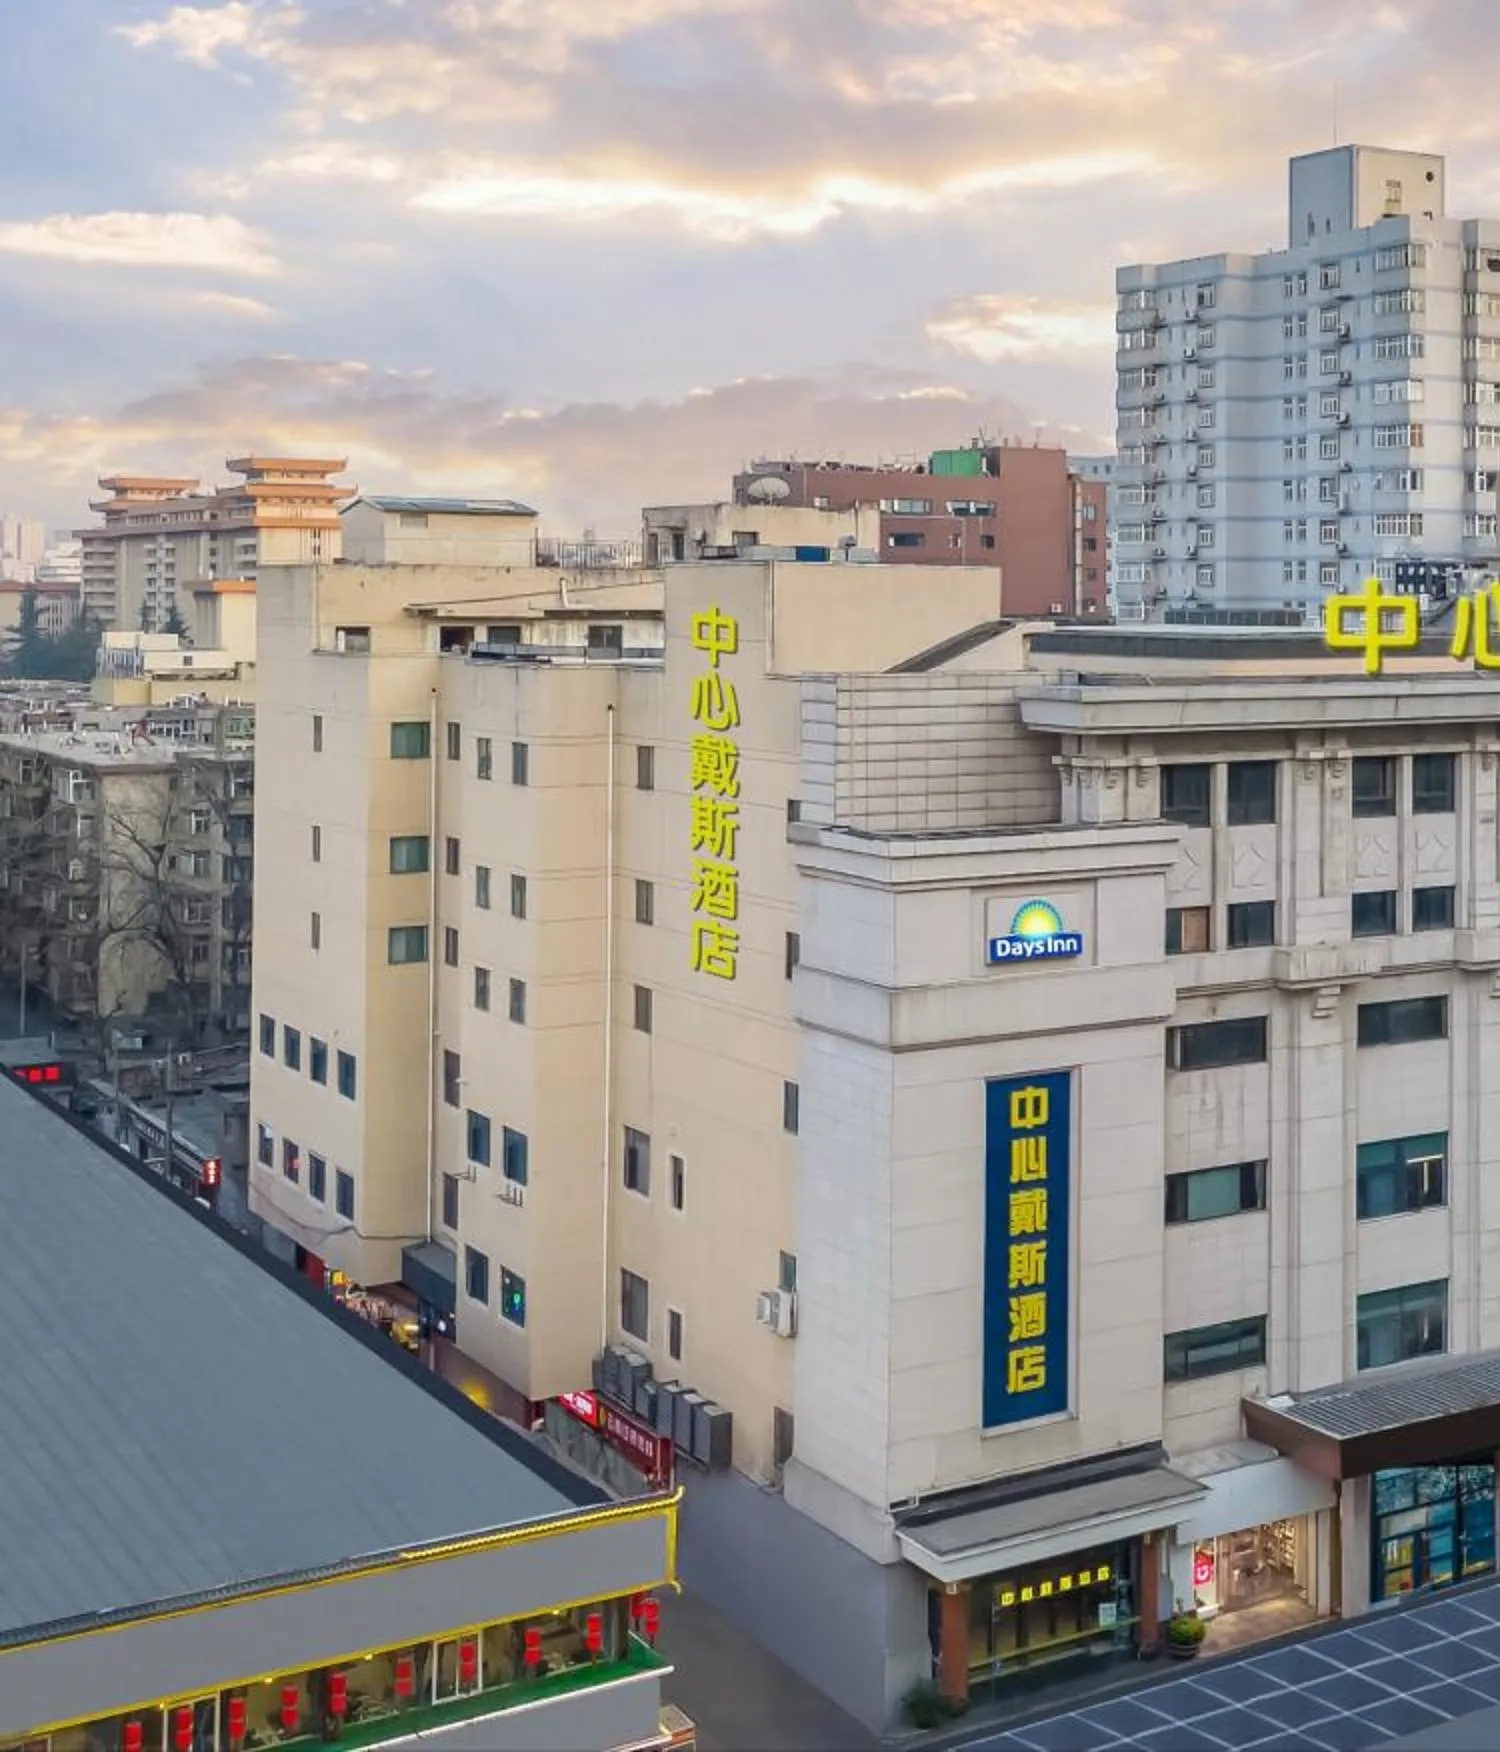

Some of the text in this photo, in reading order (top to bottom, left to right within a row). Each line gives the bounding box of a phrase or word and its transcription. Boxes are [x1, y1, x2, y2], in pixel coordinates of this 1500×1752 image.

[690, 607, 740, 981] 中心戴斯酒店
[1007, 1087, 1050, 1395] 中心戴斯酒店
